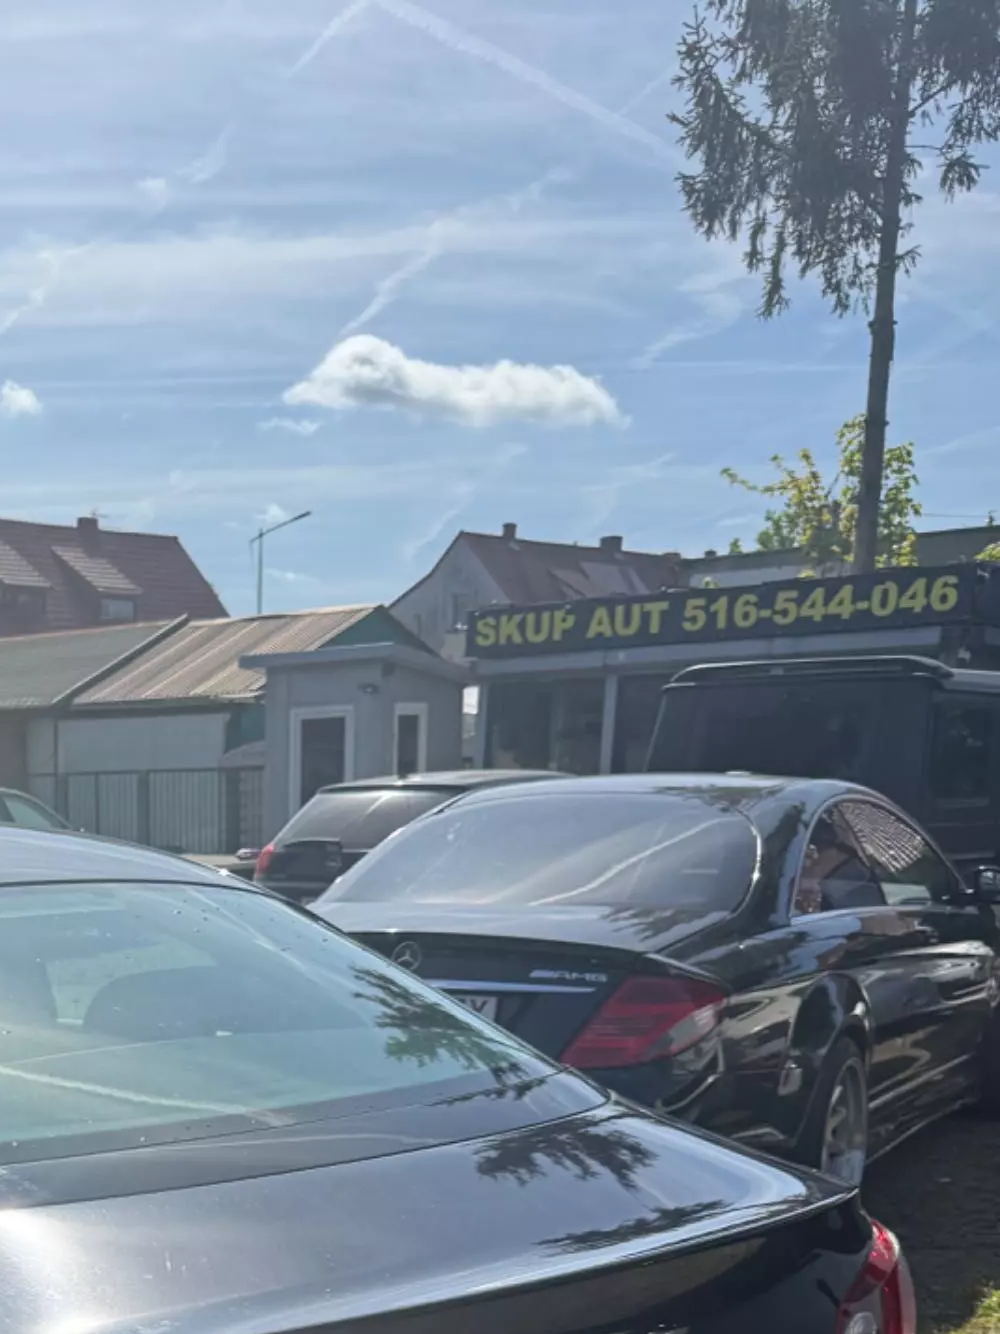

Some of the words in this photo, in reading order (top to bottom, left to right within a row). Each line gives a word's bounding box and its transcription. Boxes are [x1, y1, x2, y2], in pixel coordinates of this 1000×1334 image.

[475, 606, 574, 648] SKUP
[586, 602, 669, 640] AUT
[682, 575, 960, 632] 516-544-046
[552, 970, 608, 982] AMG
